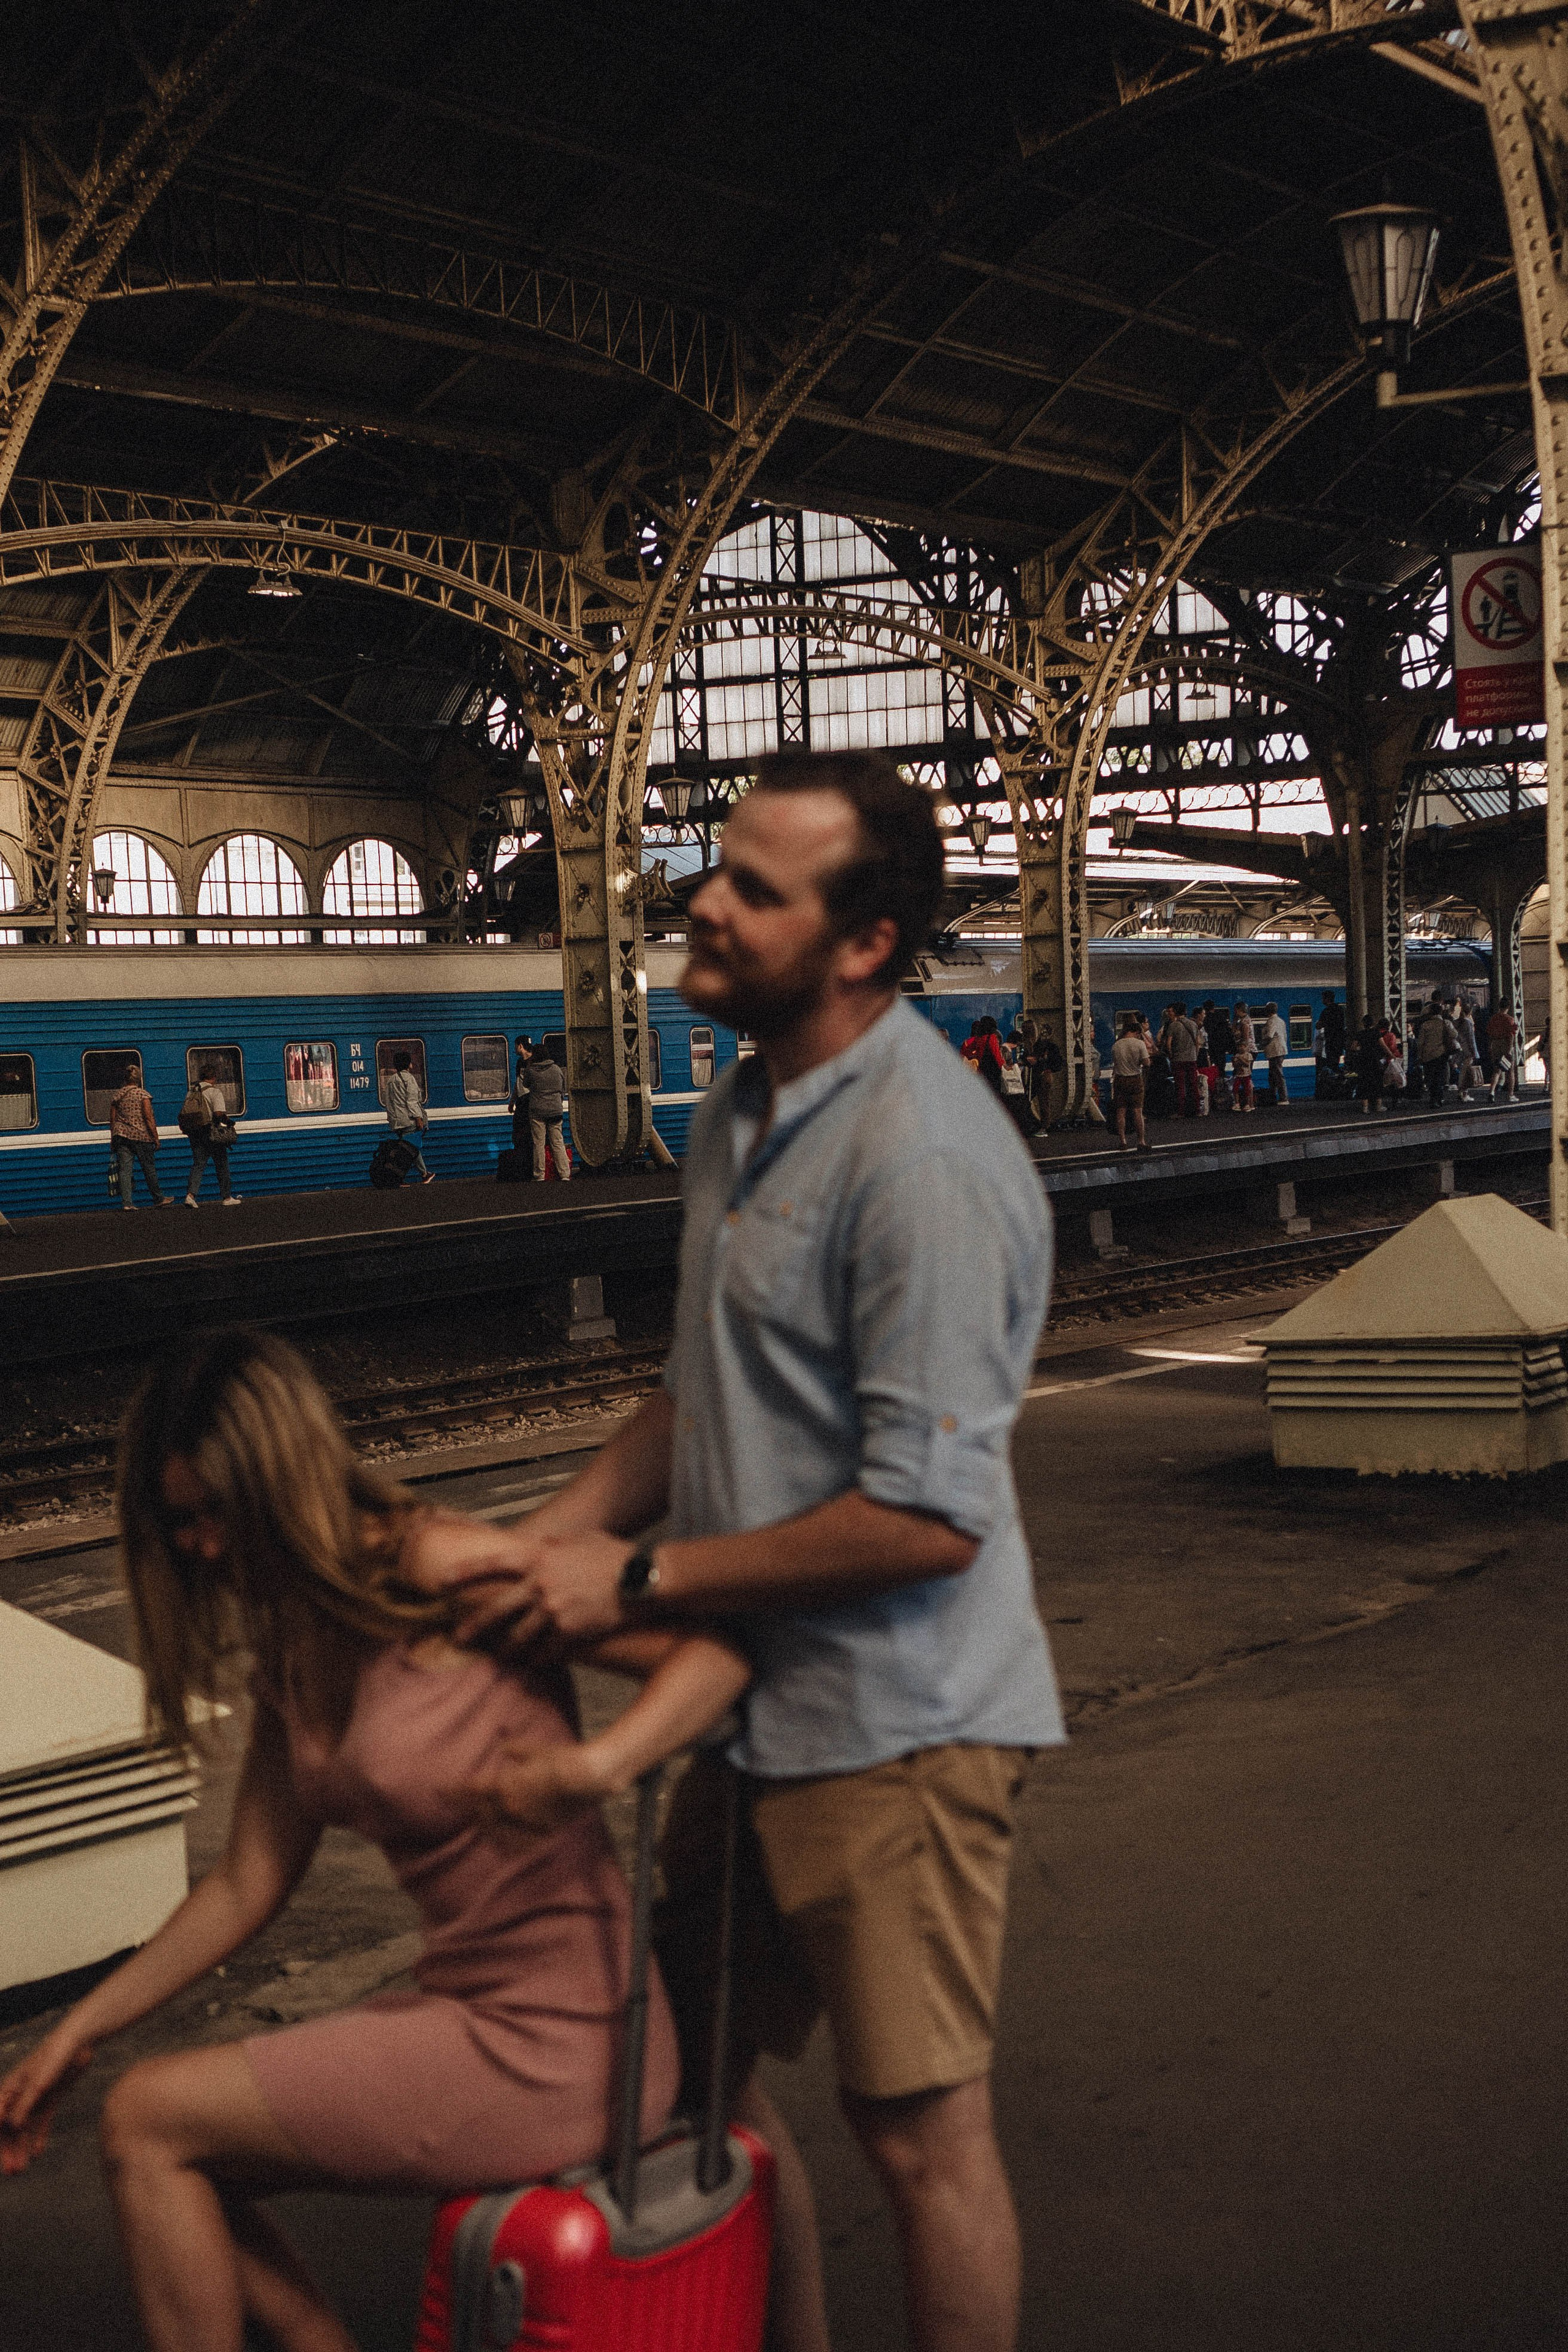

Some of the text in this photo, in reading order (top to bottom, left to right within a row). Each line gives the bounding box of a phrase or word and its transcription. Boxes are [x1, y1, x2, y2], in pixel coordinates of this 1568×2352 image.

[1465, 679, 1502, 689] Стоять
[350, 1044, 361, 1057] БЧ
[352, 1061, 364, 1072] 014
[350, 1077, 369, 1089] 11479
